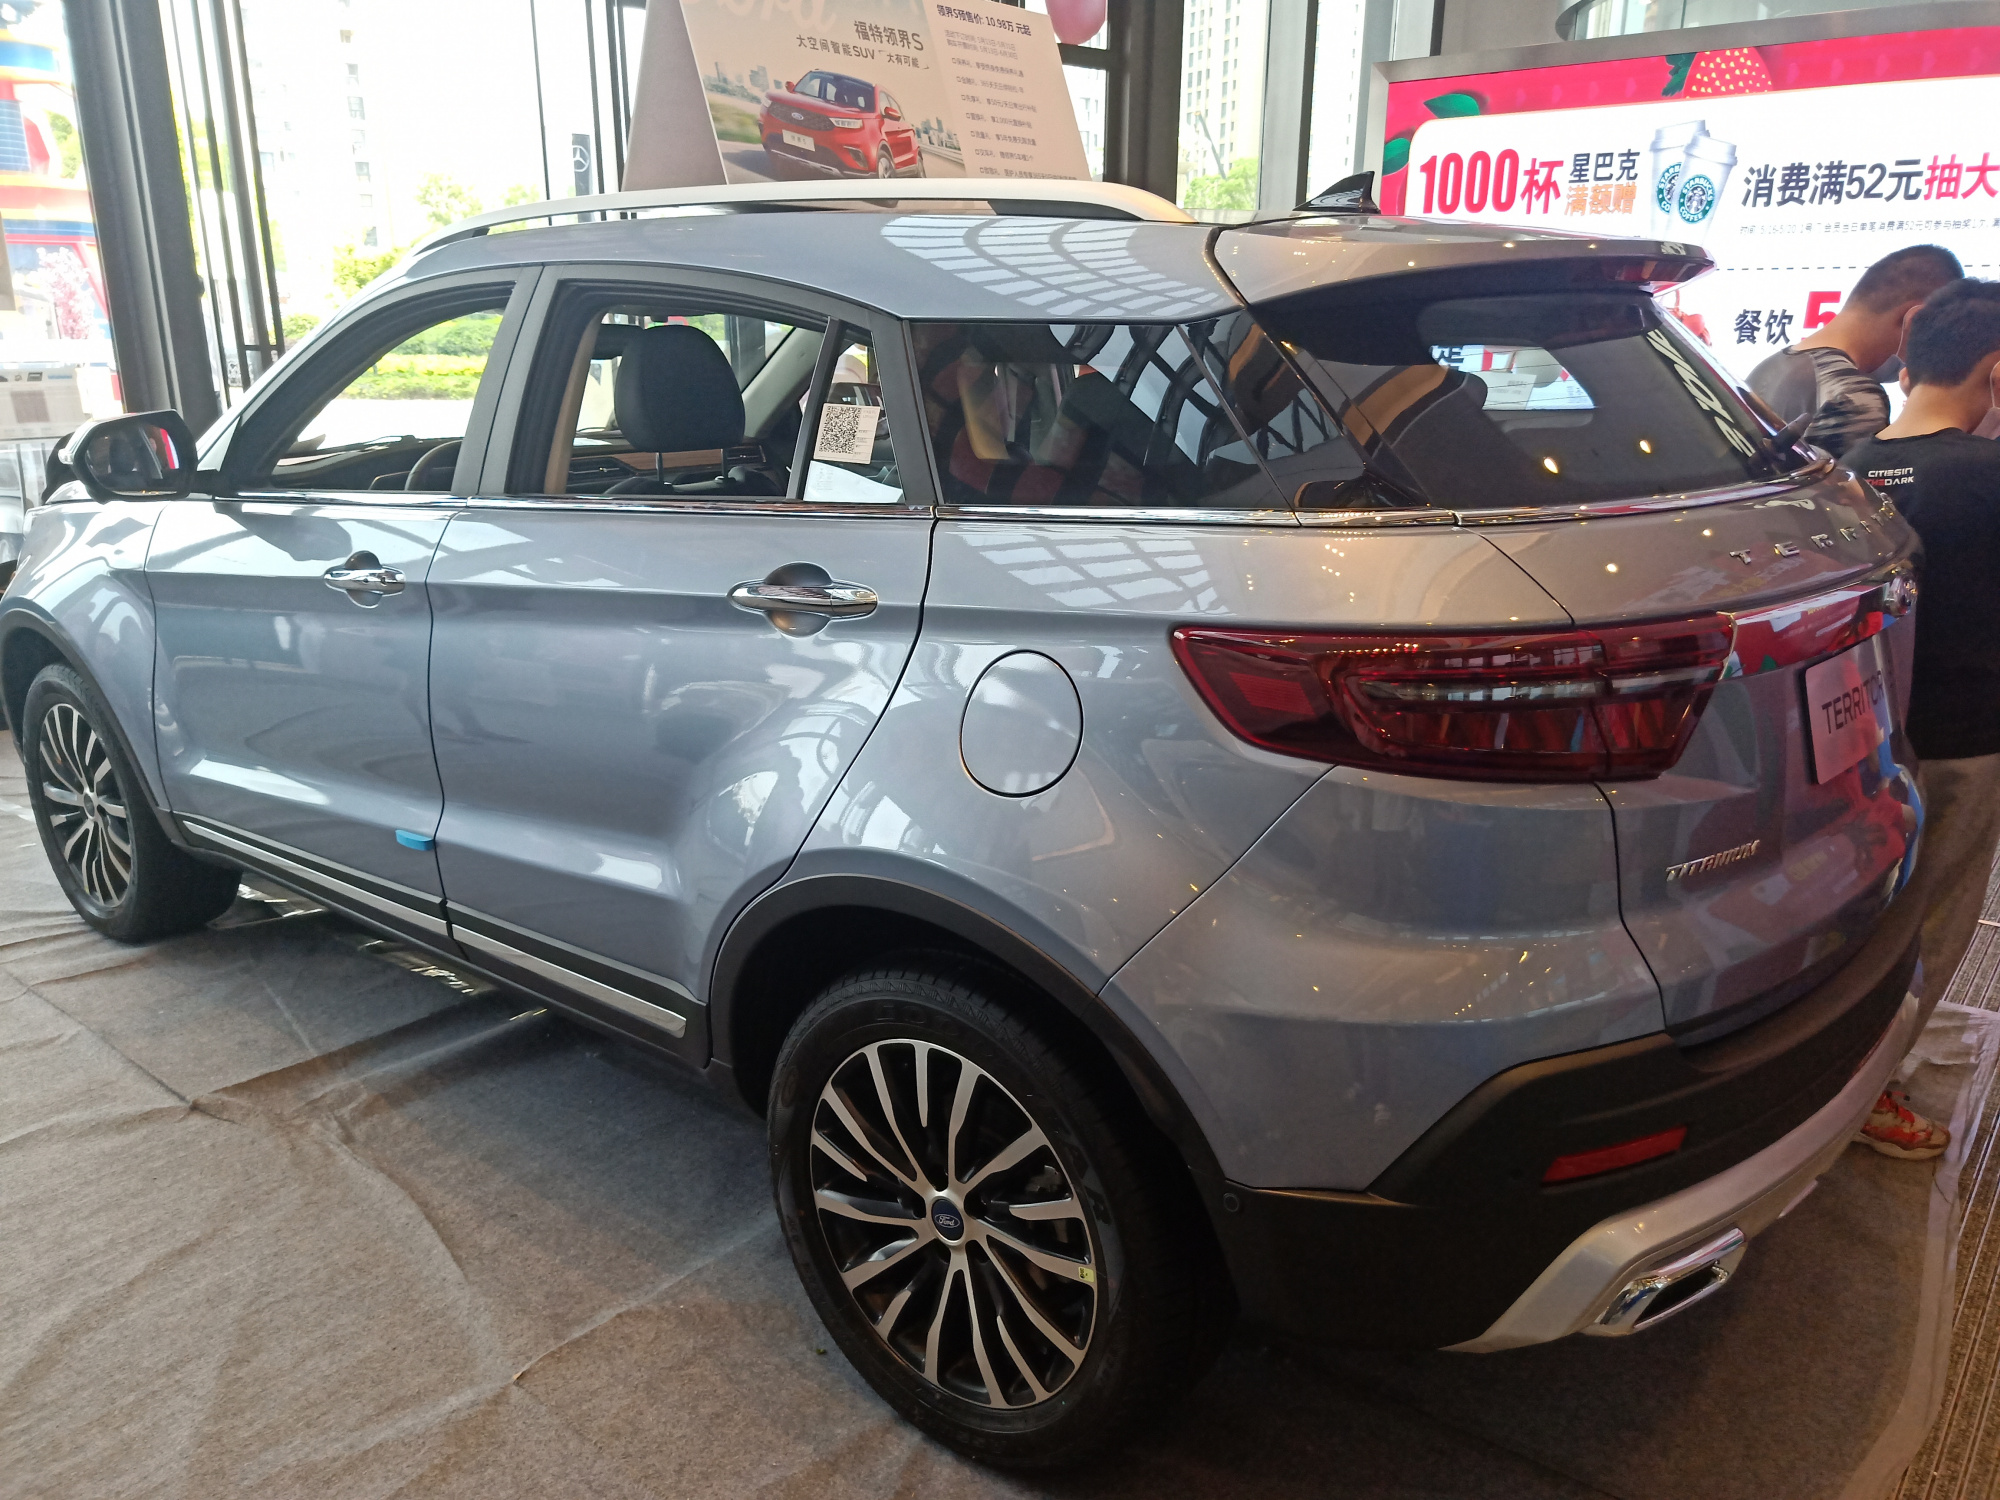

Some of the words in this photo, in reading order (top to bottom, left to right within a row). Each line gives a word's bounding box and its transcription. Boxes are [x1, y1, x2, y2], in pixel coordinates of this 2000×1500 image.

[853, 20, 924, 51] 福特领界S
[1420, 148, 1564, 215] 1000杯
[1569, 148, 1640, 183] 星巴克
[1682, 176, 1714, 202] STARBUCKS
[1564, 180, 1637, 217] 满额赠
[1679, 205, 1704, 222] COFFEE
[1733, 308, 1794, 345] 餐饮
[938, 1215, 955, 1226] Ford
